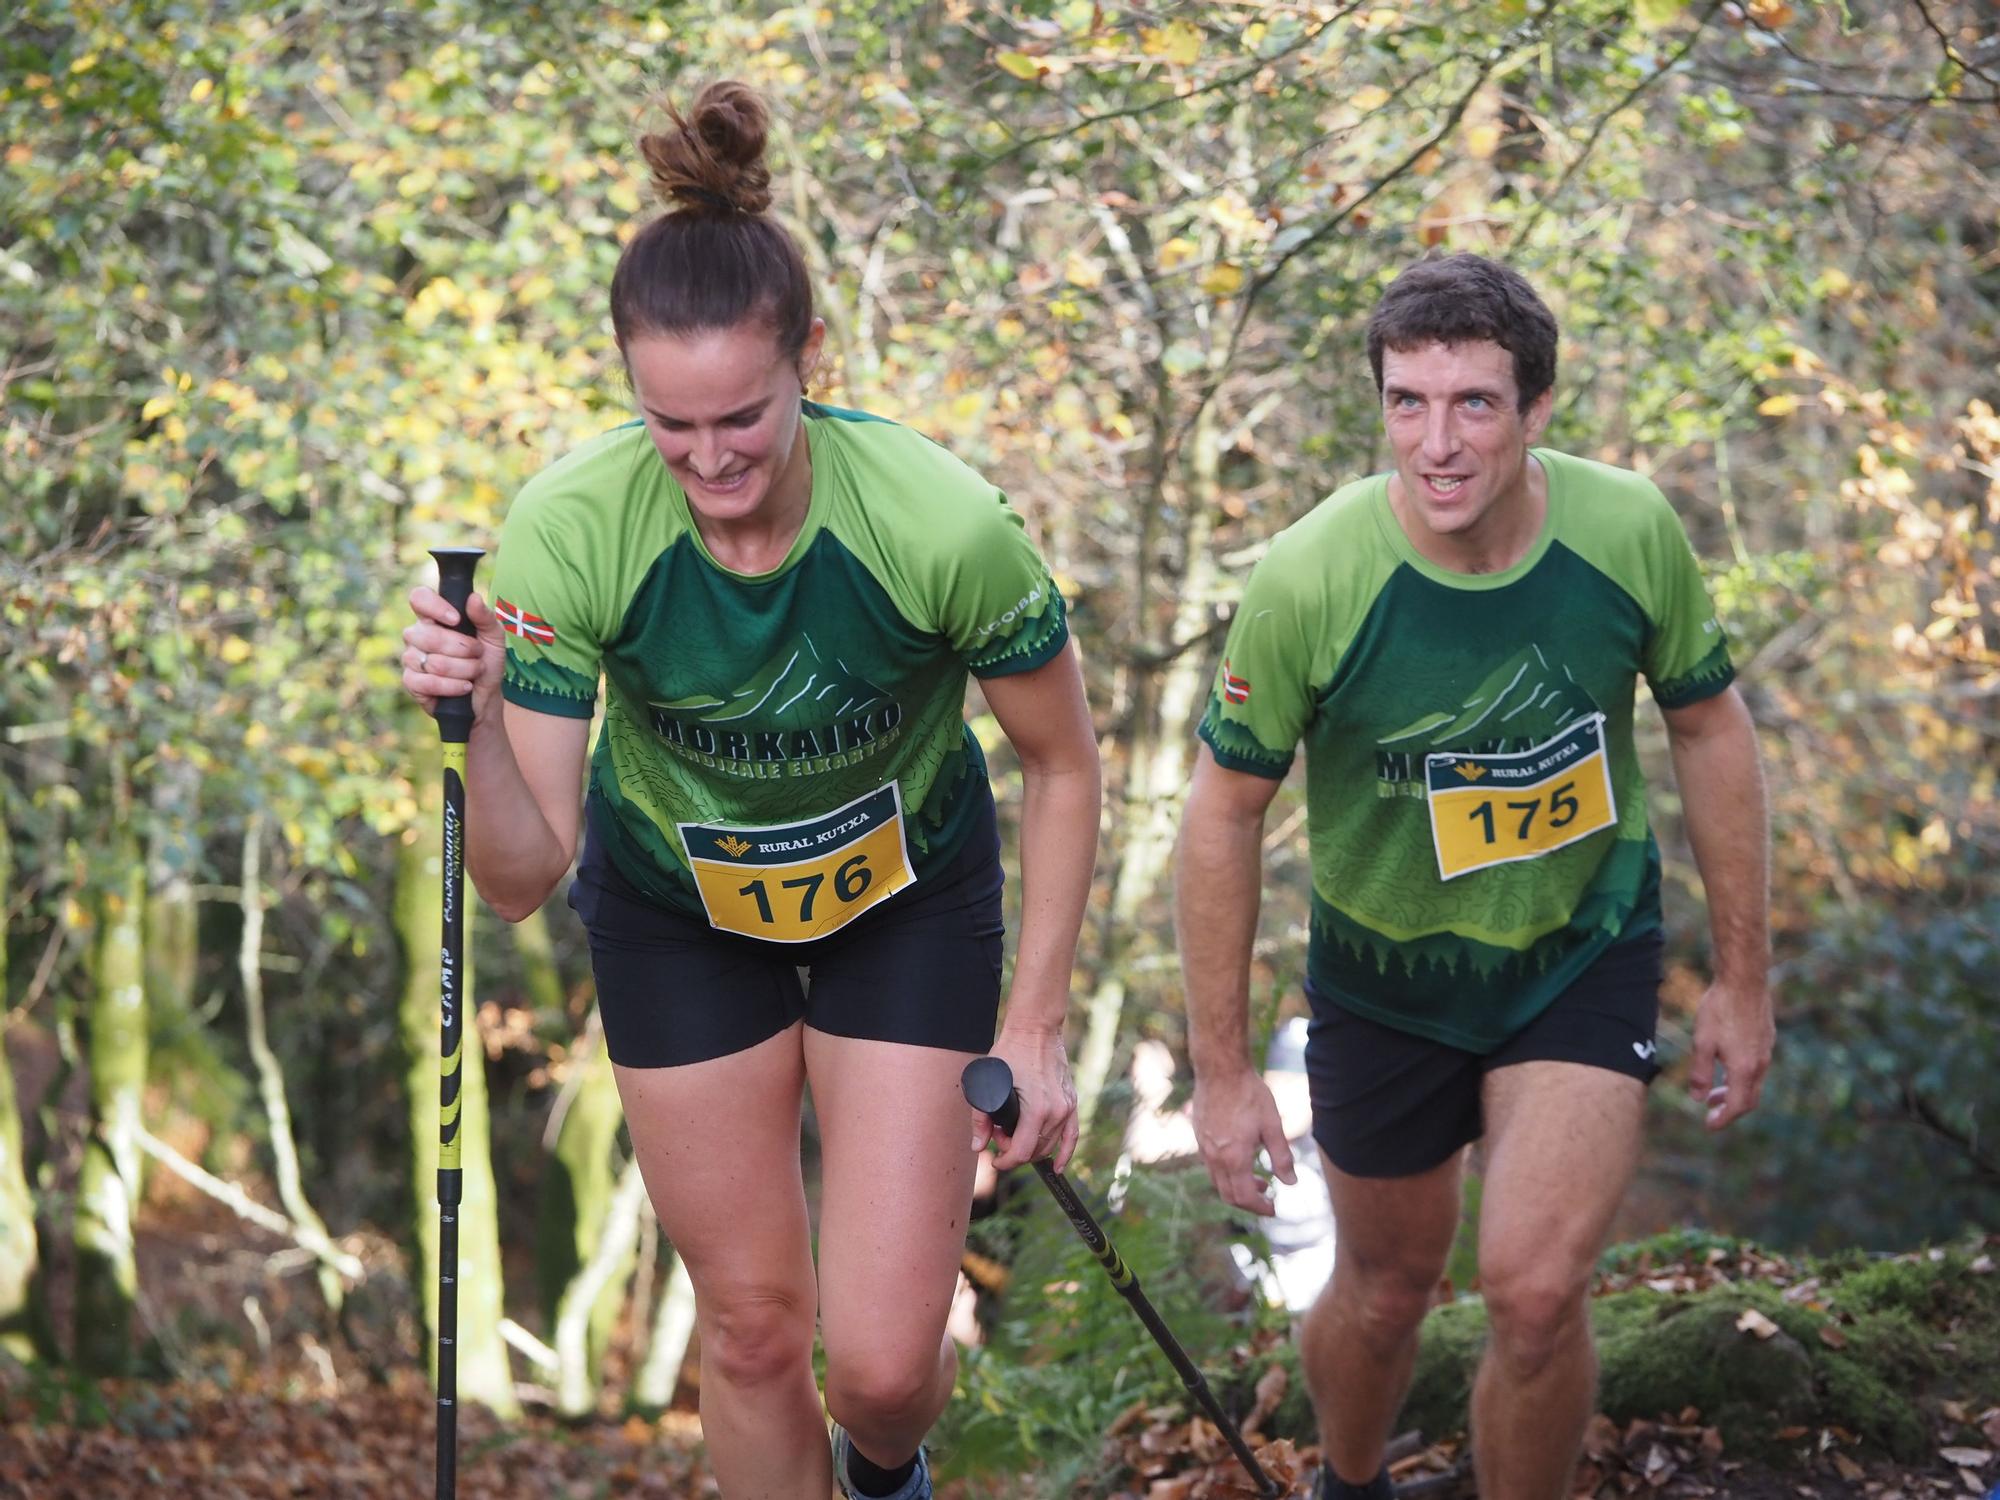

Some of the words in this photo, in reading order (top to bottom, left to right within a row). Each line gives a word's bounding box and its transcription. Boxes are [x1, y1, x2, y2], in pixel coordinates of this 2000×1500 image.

[654, 702, 902, 762] MORKAIKO
[1491, 765, 1537, 778] RURAL
[758, 837, 814, 854] RURAL
[816, 811, 870, 844] KUTXA
[1469, 782, 1579, 844] 175
[738, 854, 873, 924] 176
